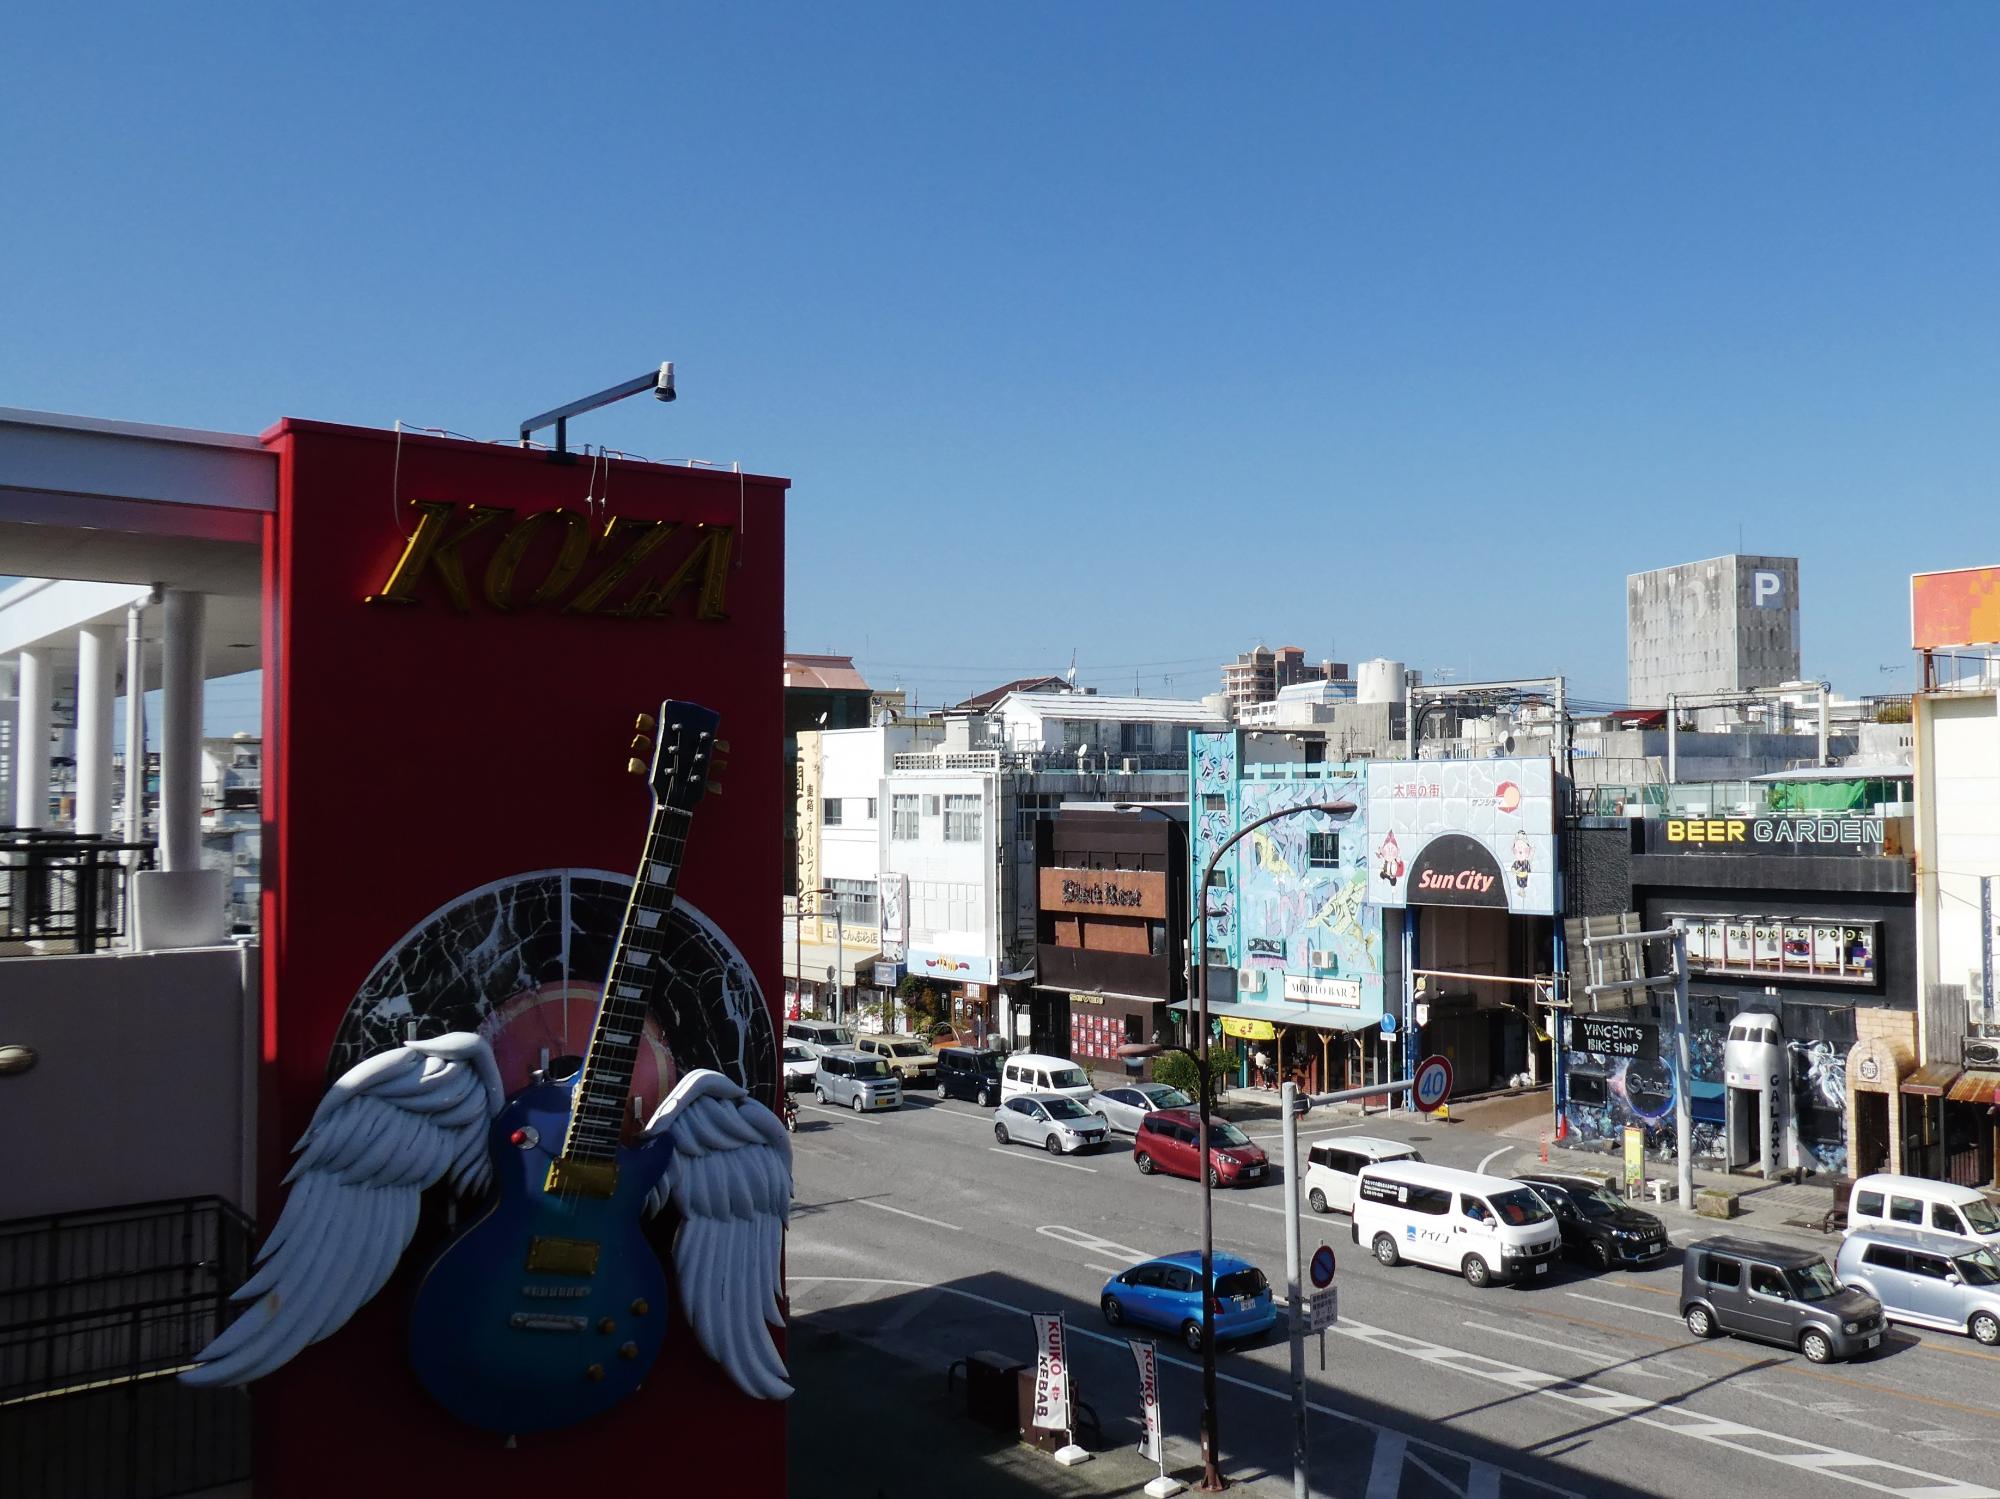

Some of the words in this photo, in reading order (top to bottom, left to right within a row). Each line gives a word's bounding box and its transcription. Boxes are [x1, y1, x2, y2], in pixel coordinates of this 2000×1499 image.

[364, 499, 734, 620] KOZA
[1755, 572, 1780, 606] P
[1394, 784, 1440, 797] 太陽の街
[1667, 820, 1746, 842] BEER
[1753, 819, 1884, 843] GARDEN
[1292, 983, 1326, 995] MOJITO
[1328, 986, 1348, 998] BAR
[1351, 985, 1357, 998] 2
[1584, 1023, 1643, 1041] VINCENT'S
[1587, 1038, 1611, 1053] BIKE
[1421, 1071, 1444, 1097] 40
[1769, 1074, 1780, 1166] GALAXY
[1047, 1320, 1062, 1376] KUIKO
[1036, 1355, 1049, 1417] KEBAB
[1143, 1349, 1155, 1407] KUIKO
